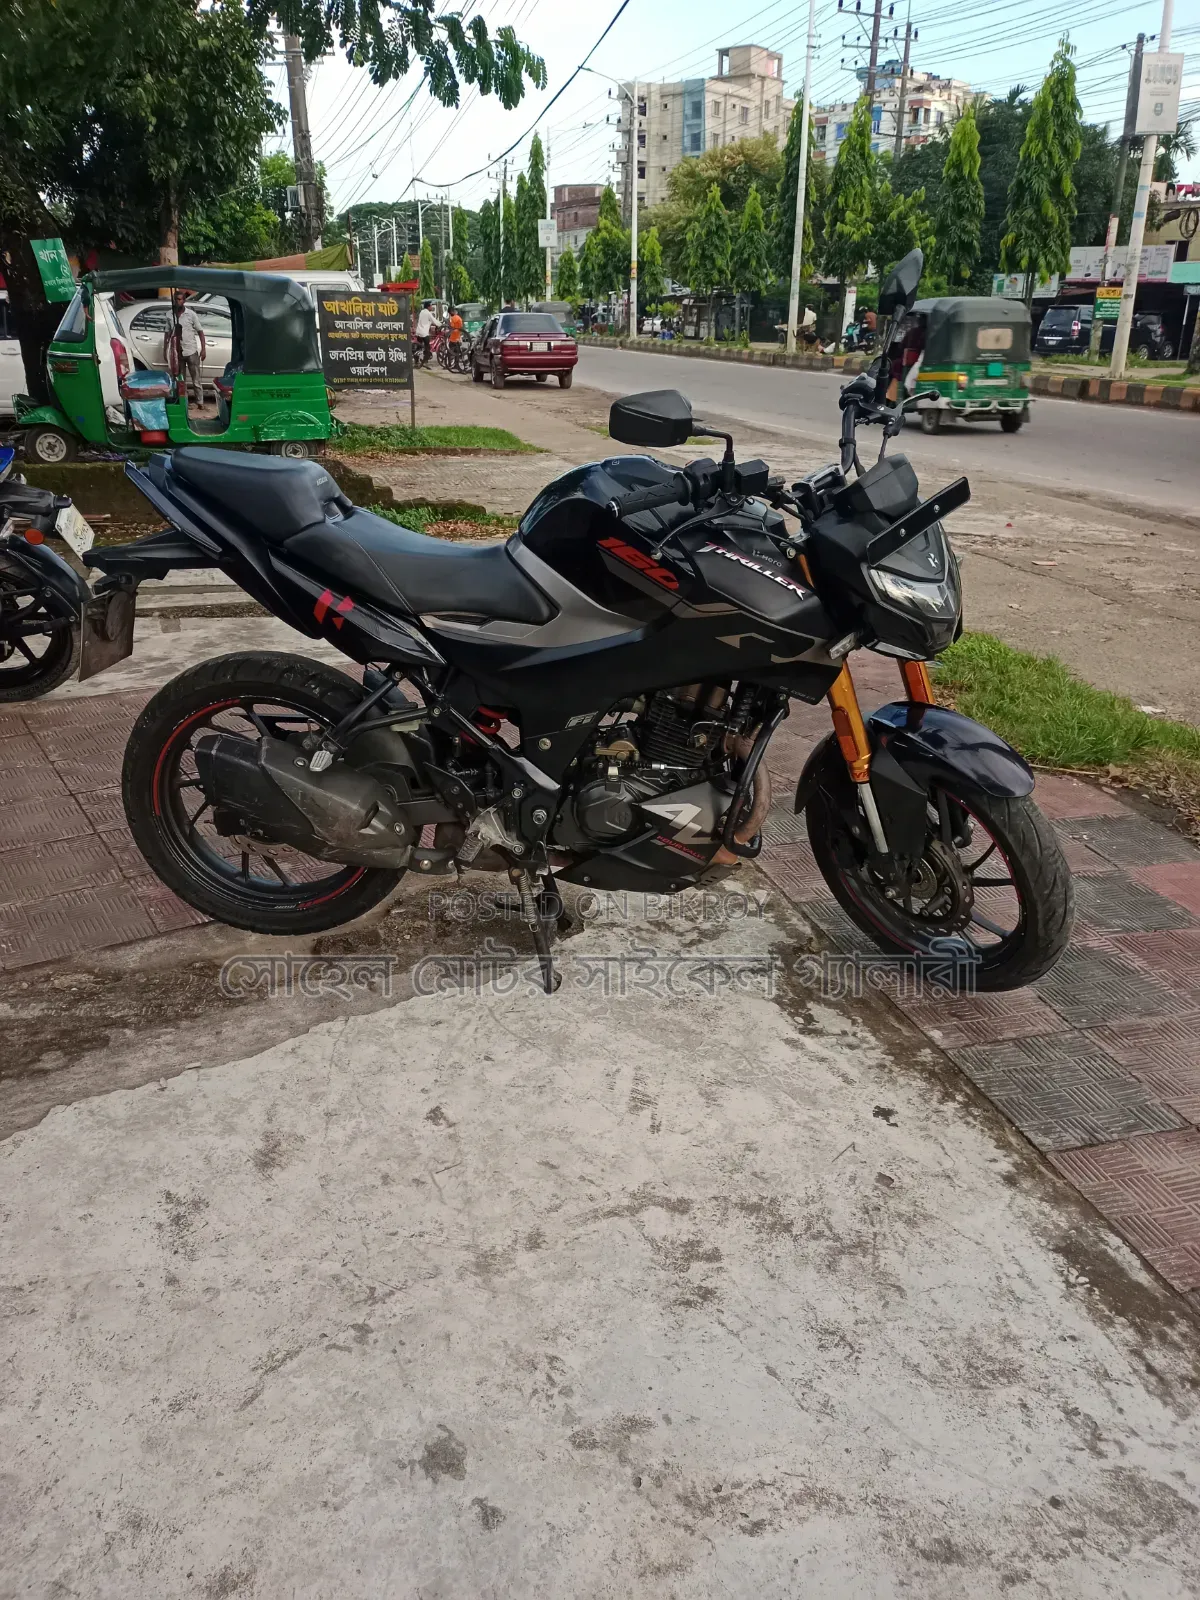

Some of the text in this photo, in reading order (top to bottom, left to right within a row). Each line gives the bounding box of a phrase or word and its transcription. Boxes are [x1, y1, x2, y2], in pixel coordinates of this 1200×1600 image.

[377, 297, 399, 317] ঘাট
[334, 317, 404, 331] আবাসিক এলাকা
[329, 346, 364, 361] জনপ্রিয়
[365, 347, 386, 362] অটো
[349, 363, 388, 377] ওয়ার্কসপ
[696, 541, 806, 601] THRILLER
